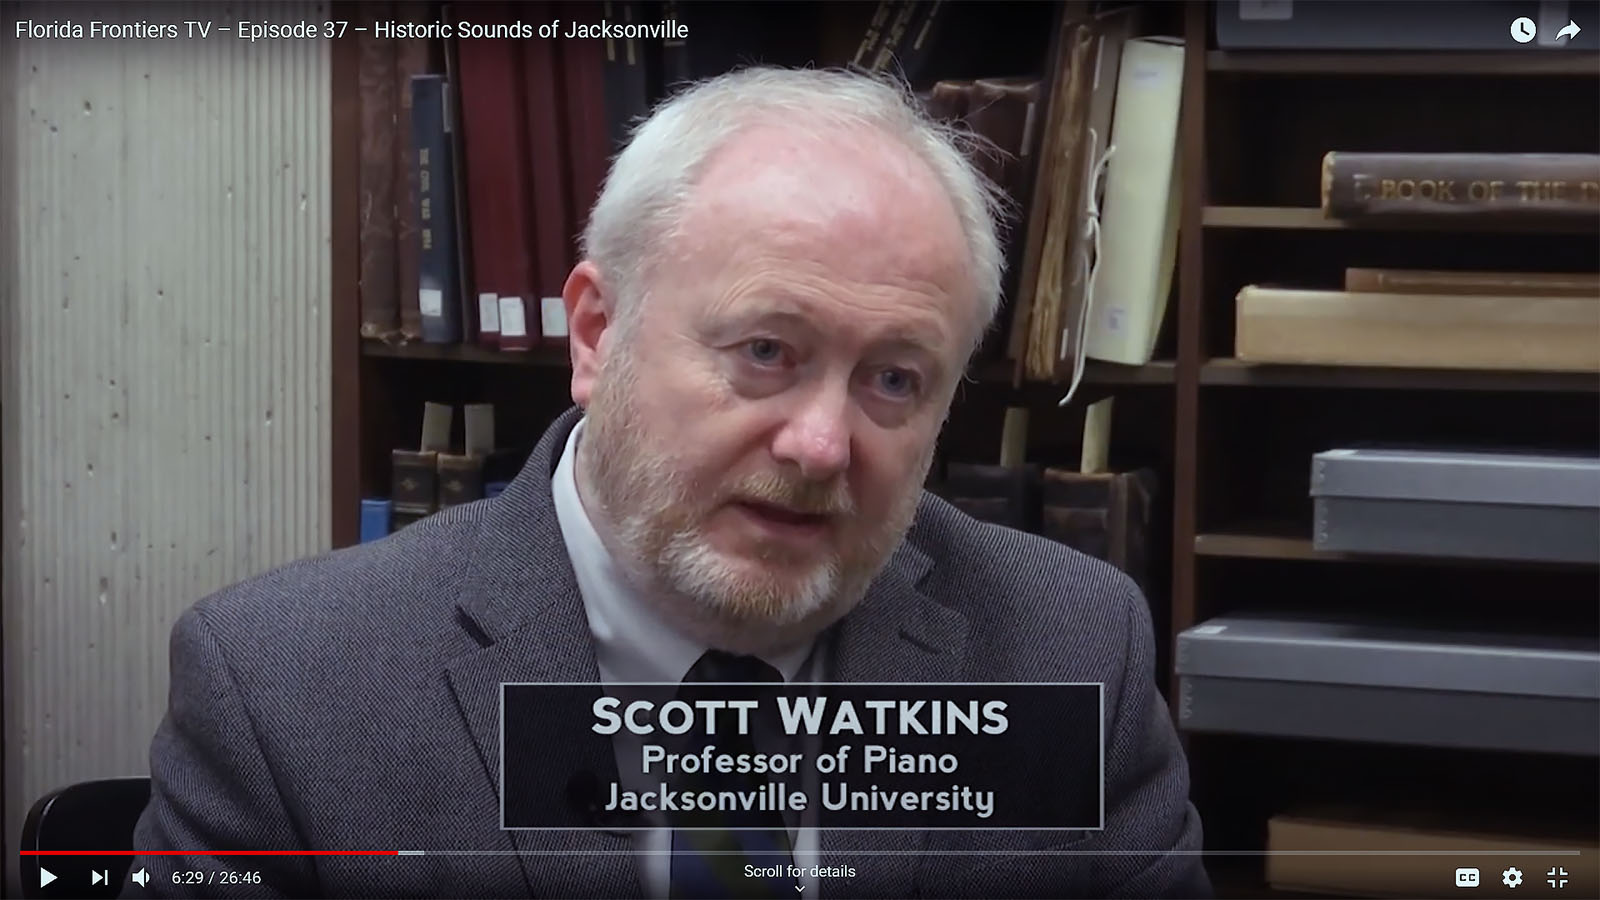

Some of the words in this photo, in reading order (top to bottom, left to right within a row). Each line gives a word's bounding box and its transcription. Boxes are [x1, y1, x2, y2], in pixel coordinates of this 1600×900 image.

[1380, 179, 1456, 202] BOOK
[1467, 180, 1505, 202] OF
[1516, 179, 1567, 203] THE
